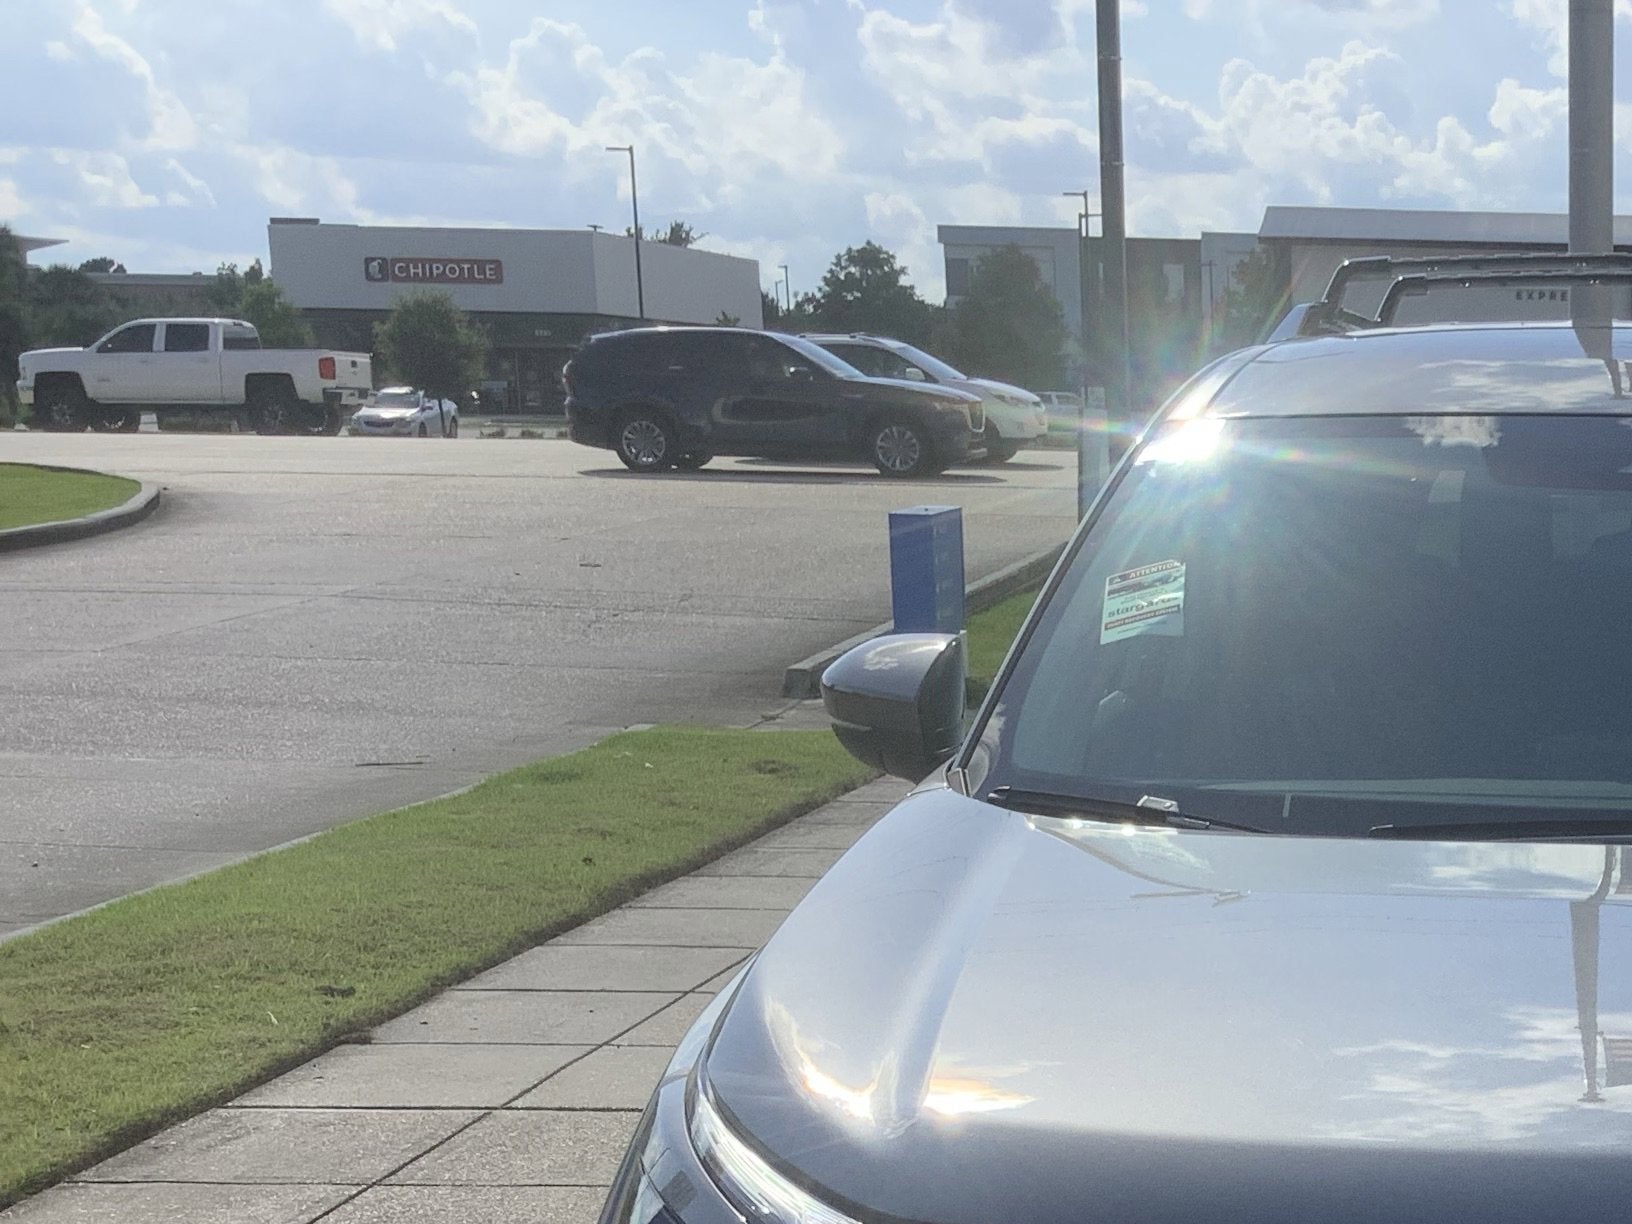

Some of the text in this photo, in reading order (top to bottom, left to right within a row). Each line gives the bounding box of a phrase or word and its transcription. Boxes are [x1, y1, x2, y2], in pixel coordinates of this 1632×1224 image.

[394, 262, 497, 280] CHIPOTLE
[1516, 290, 1569, 302] EXPRE
[1129, 560, 1182, 579] ATTENTION
